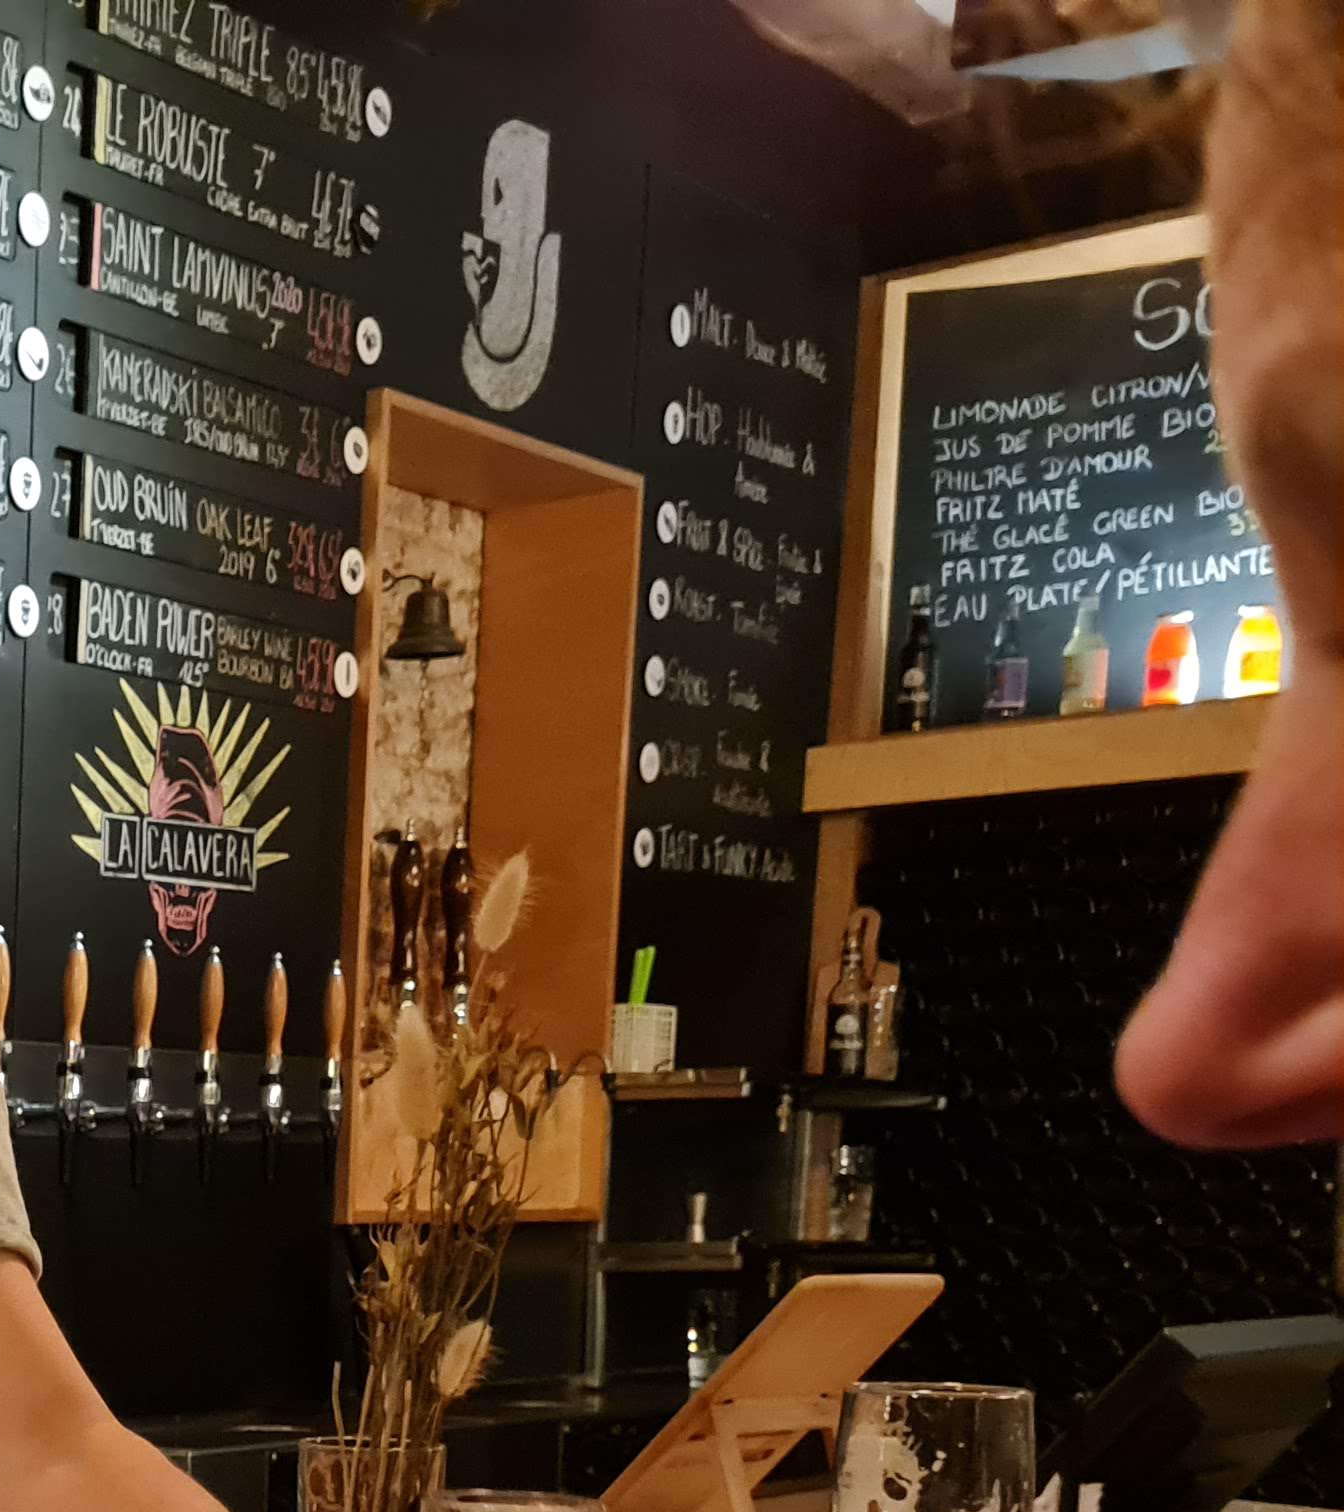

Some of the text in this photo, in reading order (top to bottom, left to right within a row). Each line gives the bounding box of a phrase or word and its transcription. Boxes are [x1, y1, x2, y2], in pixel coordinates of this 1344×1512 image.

[208, 2, 276, 83] TRIPLE
[106, 83, 129, 147] LE
[137, 92, 233, 189] ROBUSTE
[101, 206, 165, 282] SAINT
[171, 234, 272, 320] LAMVINUS
[931, 391, 1068, 431] LIMONADE
[934, 402, 1217, 463] JUS DE POMME BIO
[93, 465, 130, 513] OUD
[195, 496, 232, 543] OAK
[236, 504, 276, 552] LEAF
[931, 460, 1029, 494] PHILTRE
[934, 478, 1083, 526] FRITZ MATÉ
[992, 513, 1071, 550] GLACÉ
[1091, 502, 1175, 536] GREEN
[1197, 484, 1245, 517] BIO
[218, 544, 257, 581] 2019
[932, 542, 1277, 630] EAU PLATE PÉTILLANTE
[940, 544, 1116, 588] FRITZ COLA
[85, 581, 151, 647] BADEN
[104, 819, 254, 881] LA CALAVERA
